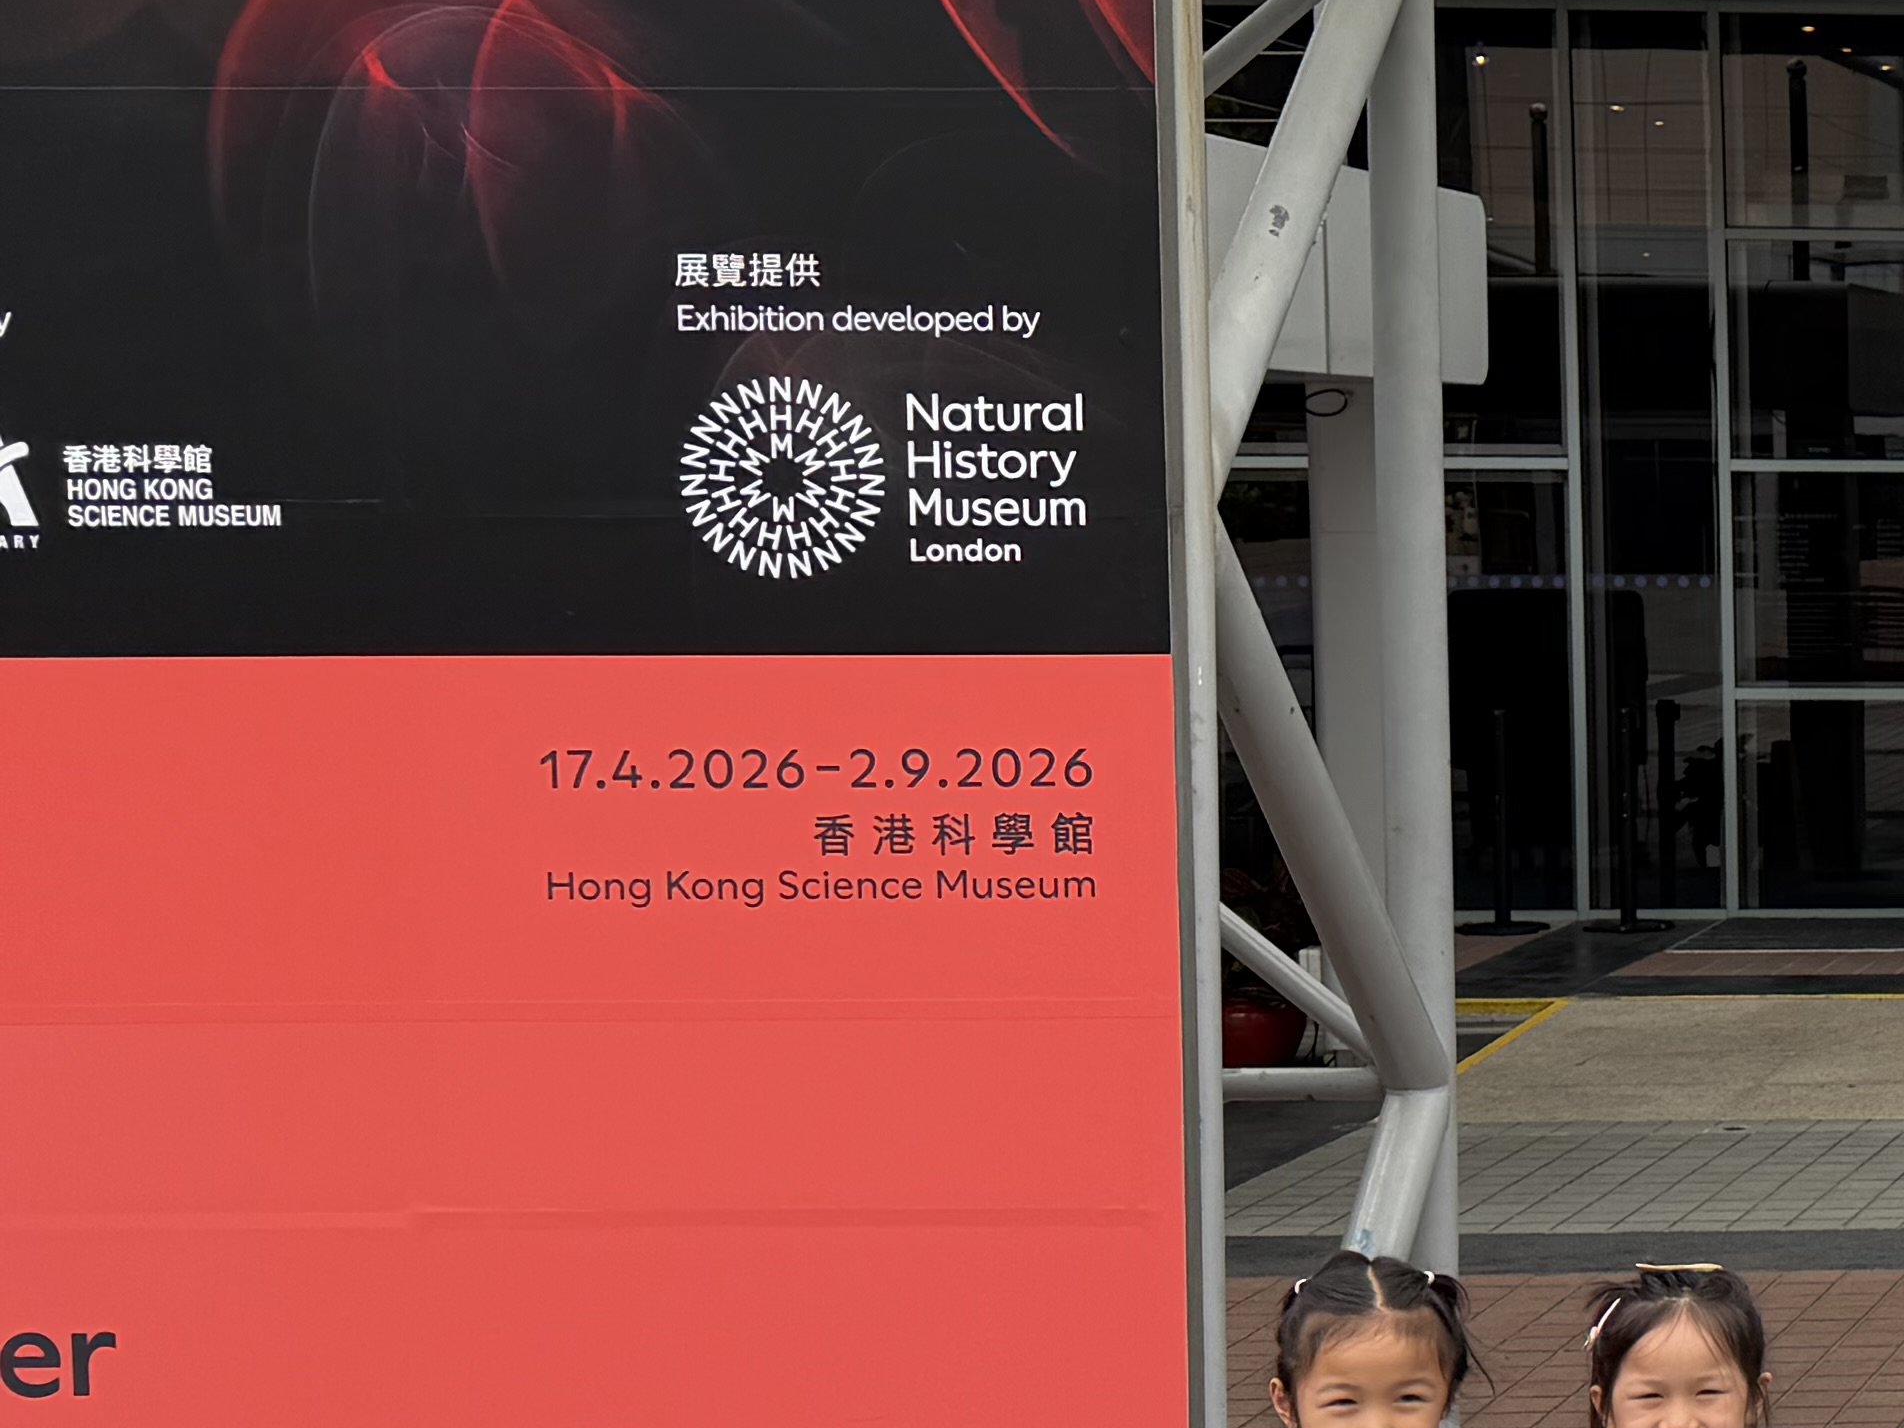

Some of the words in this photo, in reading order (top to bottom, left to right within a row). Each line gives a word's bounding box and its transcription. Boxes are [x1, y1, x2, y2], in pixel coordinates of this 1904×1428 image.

[674, 252, 821, 288] 展覽提供
[676, 304, 825, 332] Exhibition
[831, 304, 994, 338] developed
[1002, 304, 1041, 339] by
[905, 392, 1084, 433] Natural
[62, 443, 213, 474] 香港科學館
[907, 440, 1078, 487] History
[66, 478, 137, 501] HONG
[143, 478, 214, 501] KONG
[908, 487, 1088, 527] Museum
[67, 504, 171, 527] SCIENCE
[178, 504, 282, 527] MUSEUM
[909, 537, 1022, 563] London
[813, 811, 1094, 857] 香港科學館
[547, 871, 651, 908] Hong
[666, 870, 764, 908] Kong
[778, 870, 922, 901] Science
[936, 870, 1096, 900] Museum
